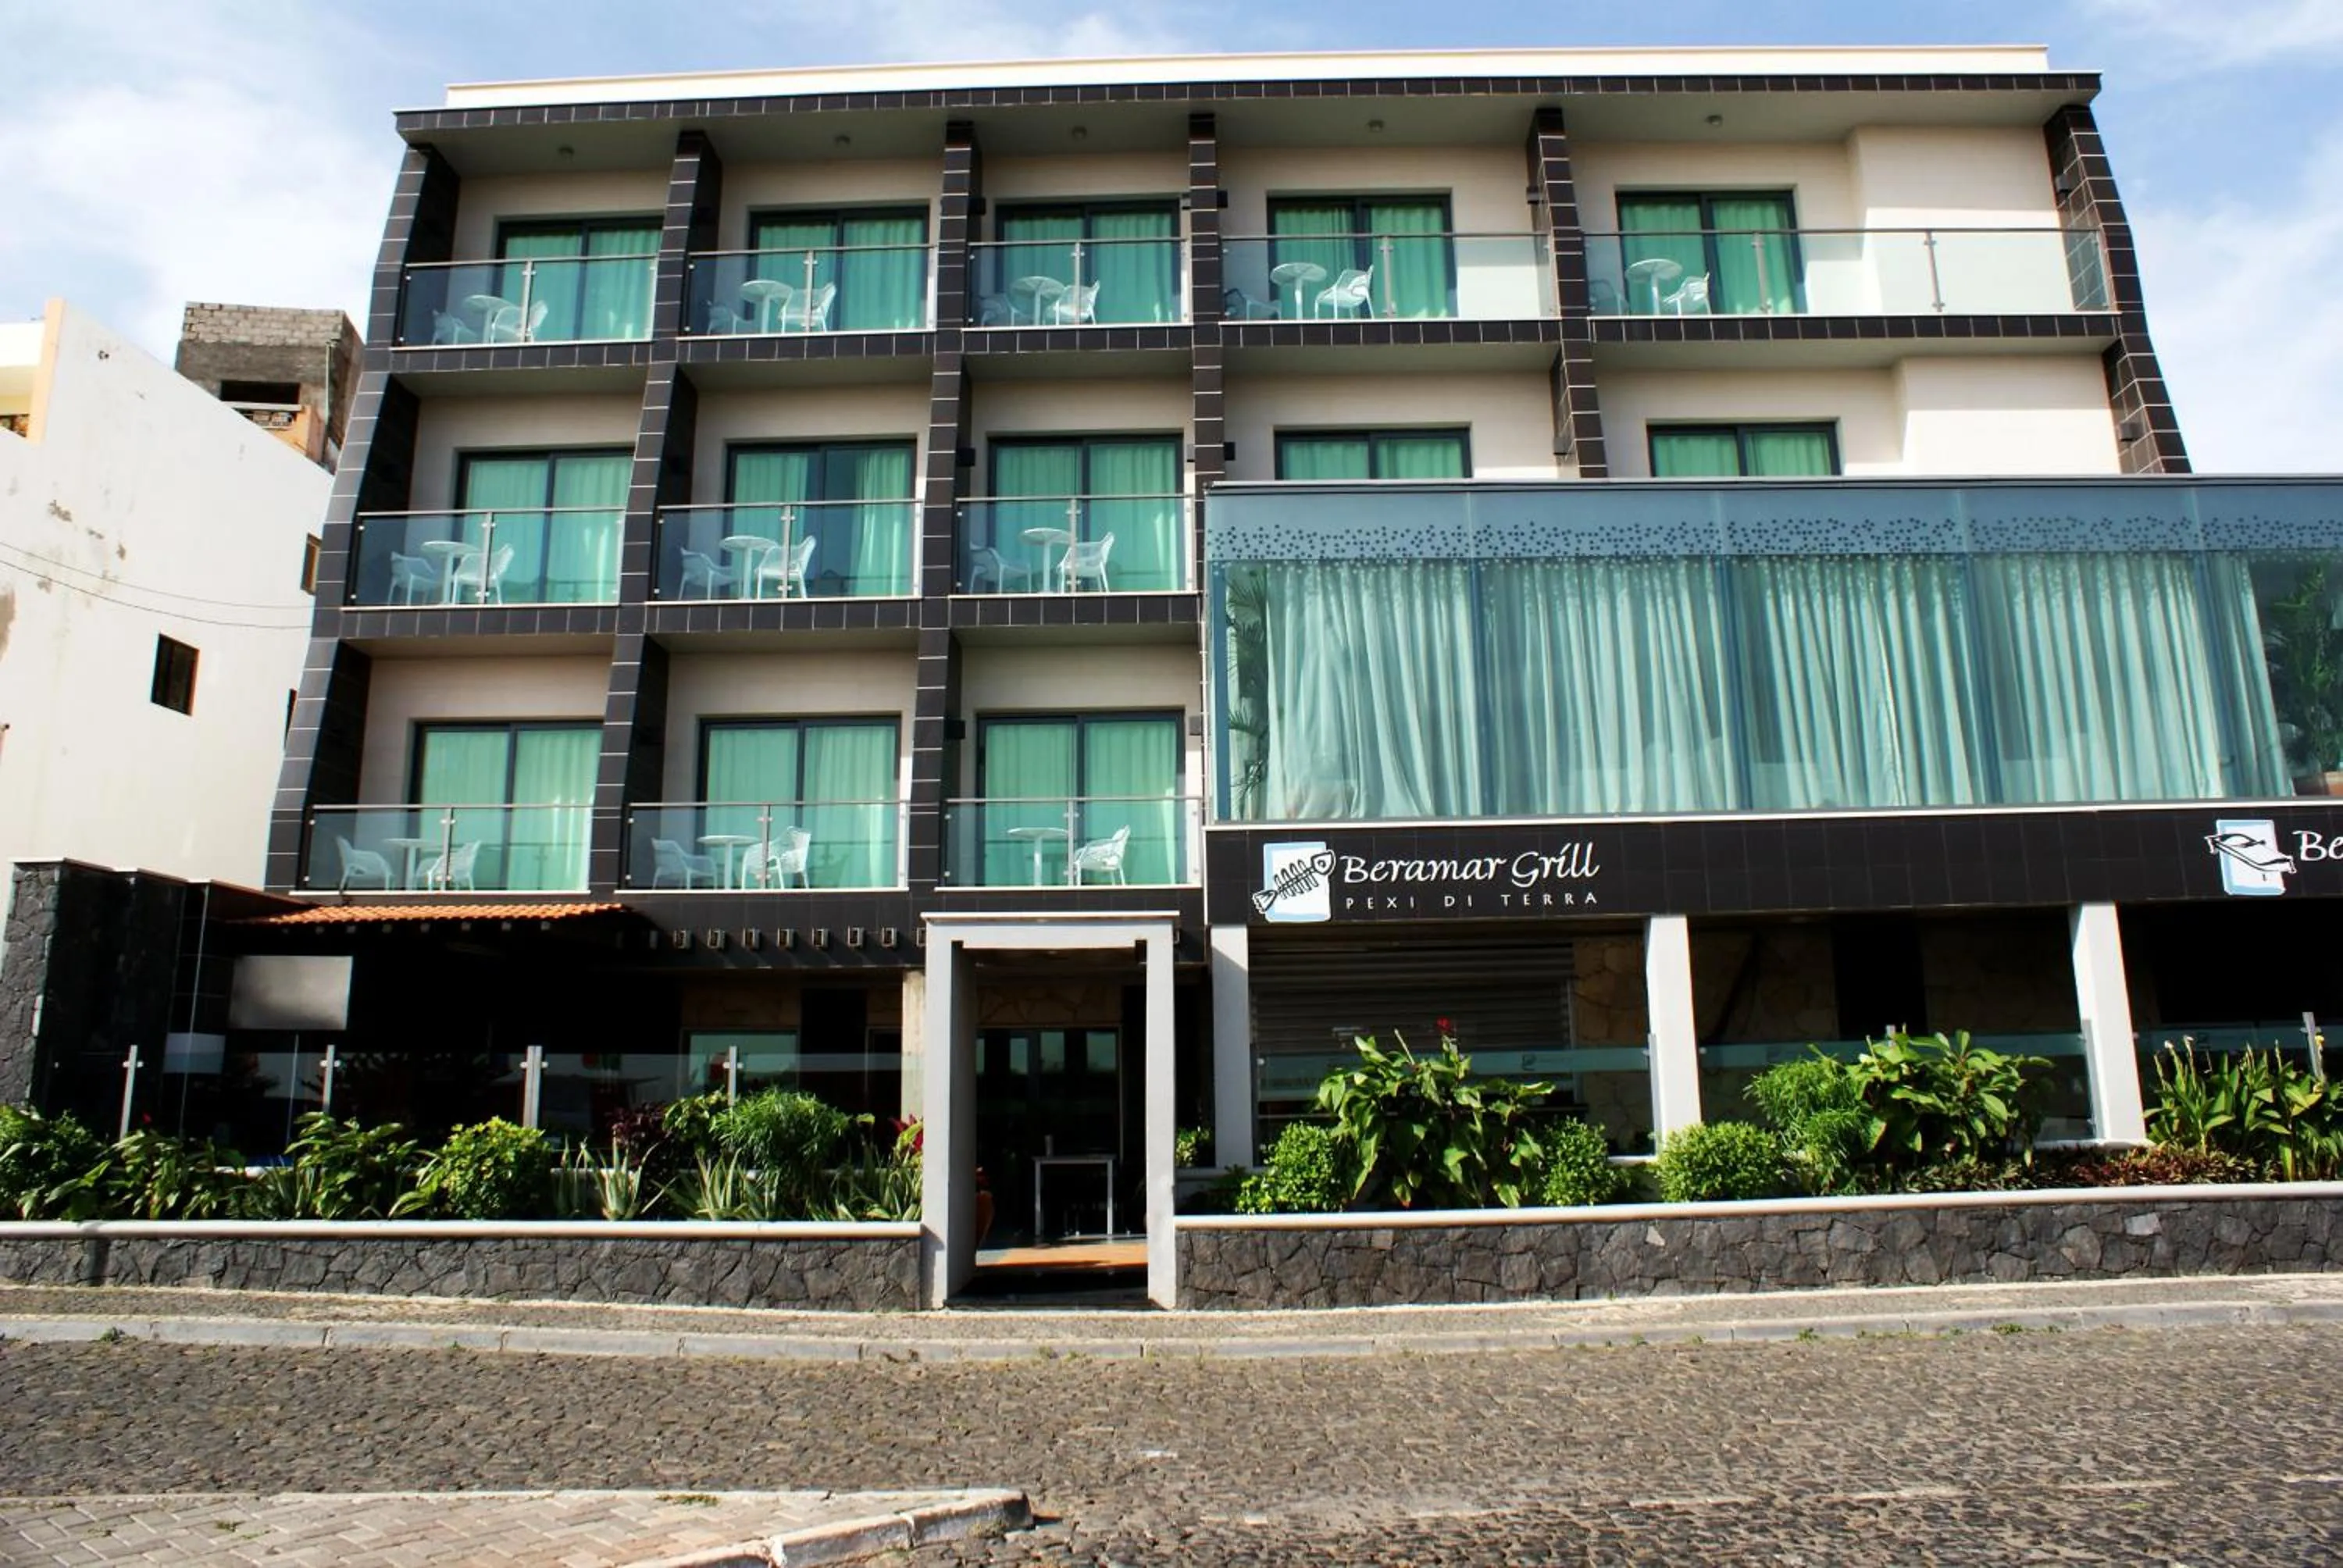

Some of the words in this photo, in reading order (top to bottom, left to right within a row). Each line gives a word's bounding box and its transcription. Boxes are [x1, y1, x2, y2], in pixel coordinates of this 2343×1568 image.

[1339, 855, 1507, 883] Beramar
[1346, 896, 1415, 910] PEXI
[1444, 896, 1473, 907] DI
[1500, 892, 1598, 907] TERRA
